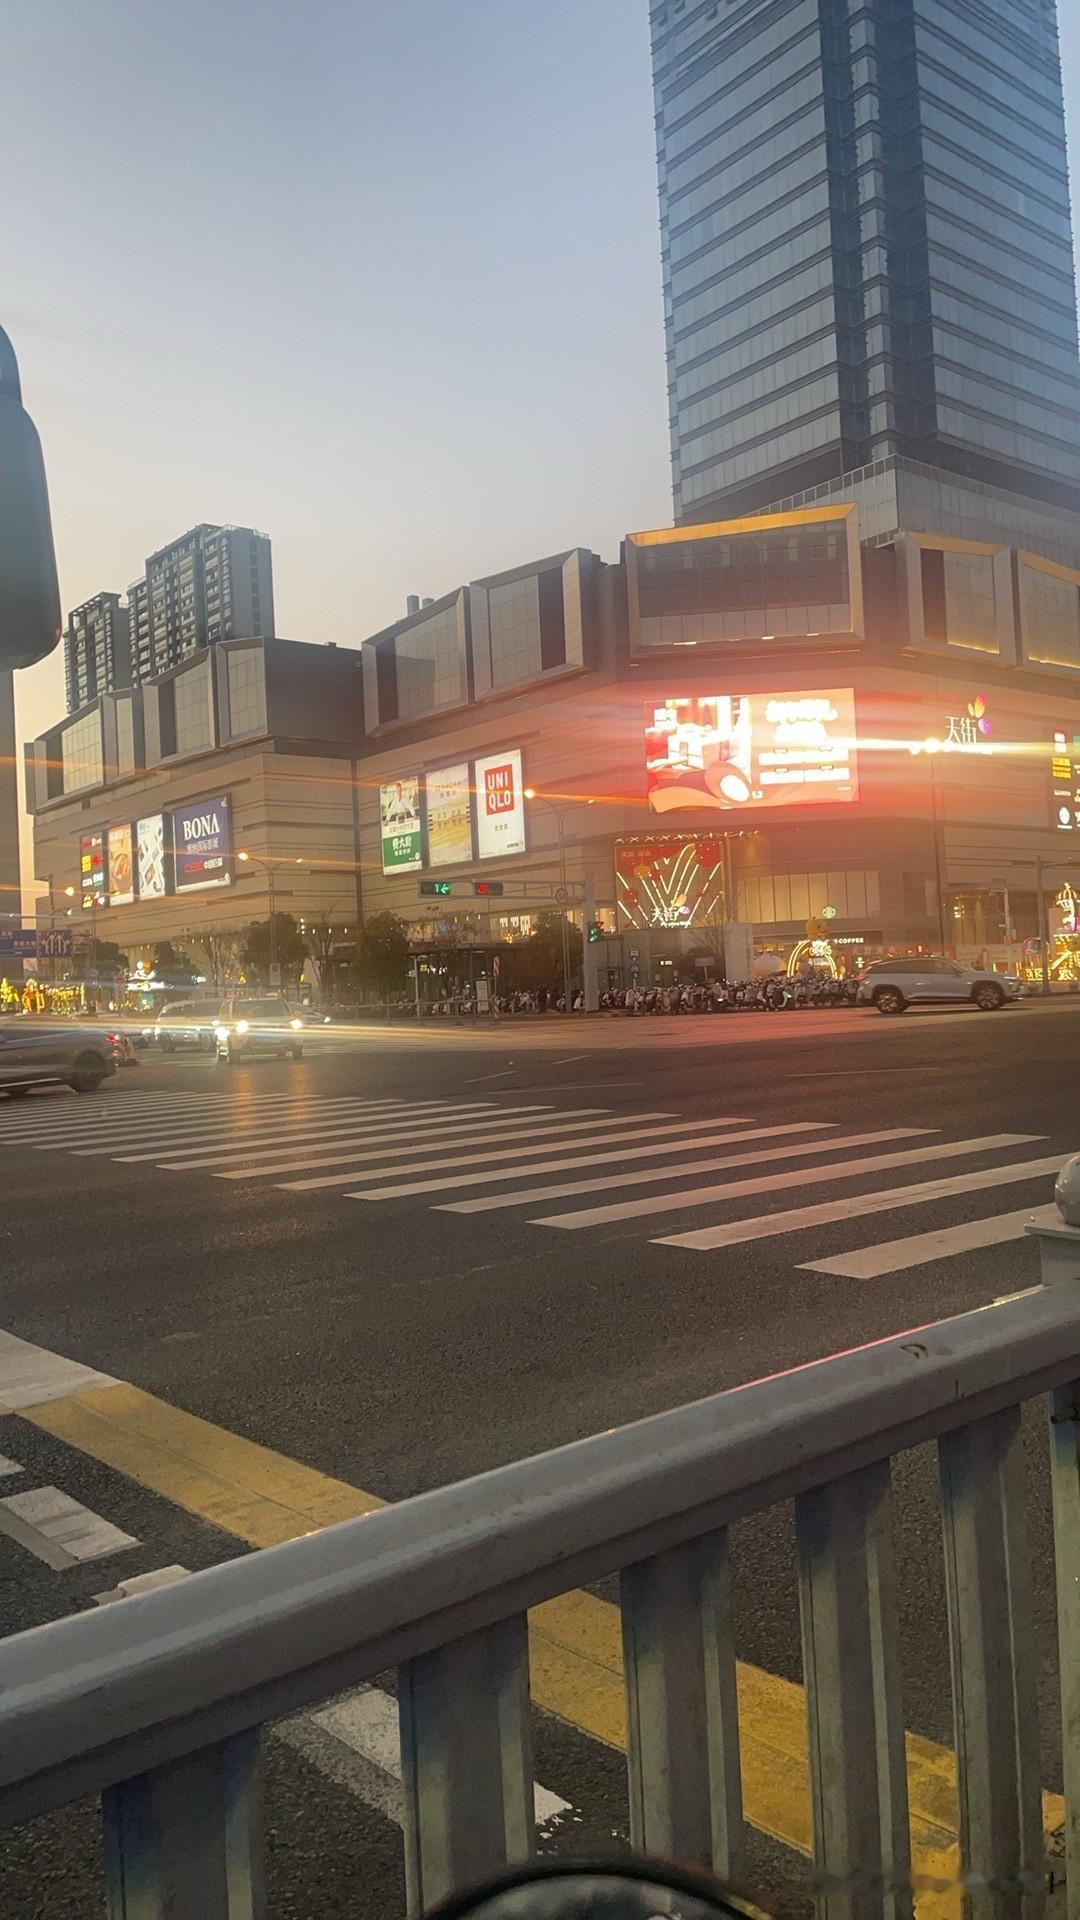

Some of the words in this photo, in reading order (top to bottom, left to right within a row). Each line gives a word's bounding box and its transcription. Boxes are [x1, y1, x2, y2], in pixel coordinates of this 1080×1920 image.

[945, 716, 976, 744] 天街
[488, 772, 509, 790] UNI
[489, 790, 511, 812] QLO
[183, 813, 220, 840] BONA
[650, 907, 679, 923] 天街
